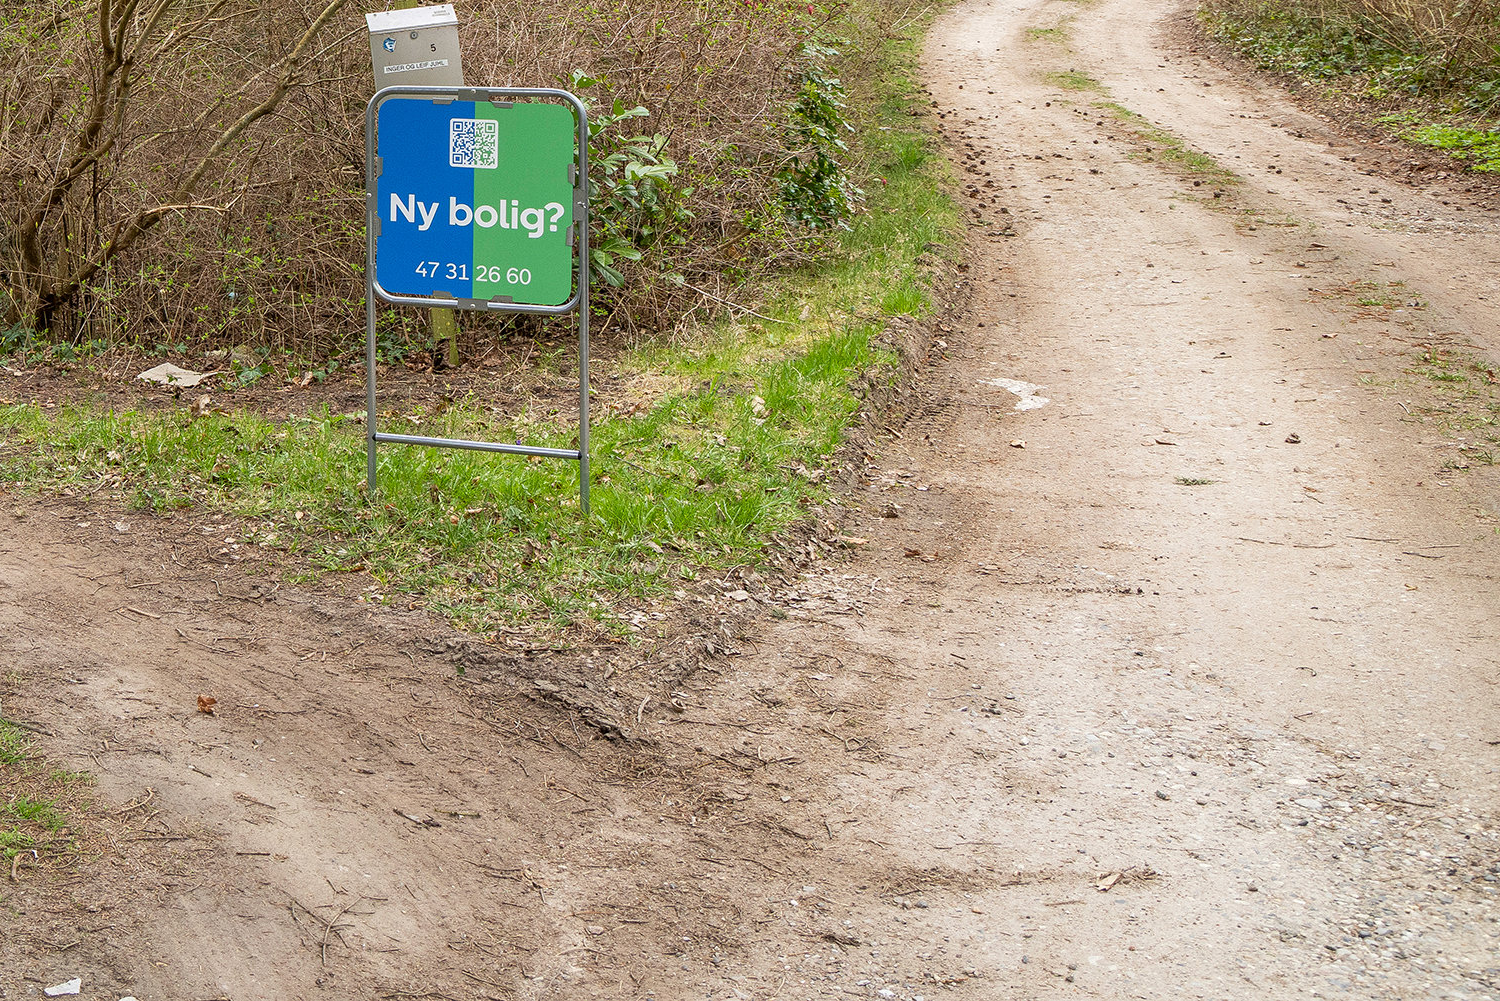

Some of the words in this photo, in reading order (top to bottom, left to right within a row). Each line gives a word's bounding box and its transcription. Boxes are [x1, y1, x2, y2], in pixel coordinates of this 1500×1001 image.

[430, 43, 437, 52] 5
[389, 193, 440, 231] Ny
[449, 196, 566, 239] bolig?
[415, 261, 439, 278] 47
[445, 263, 470, 281] 31
[475, 265, 501, 283] 26
[506, 268, 532, 285] 60
